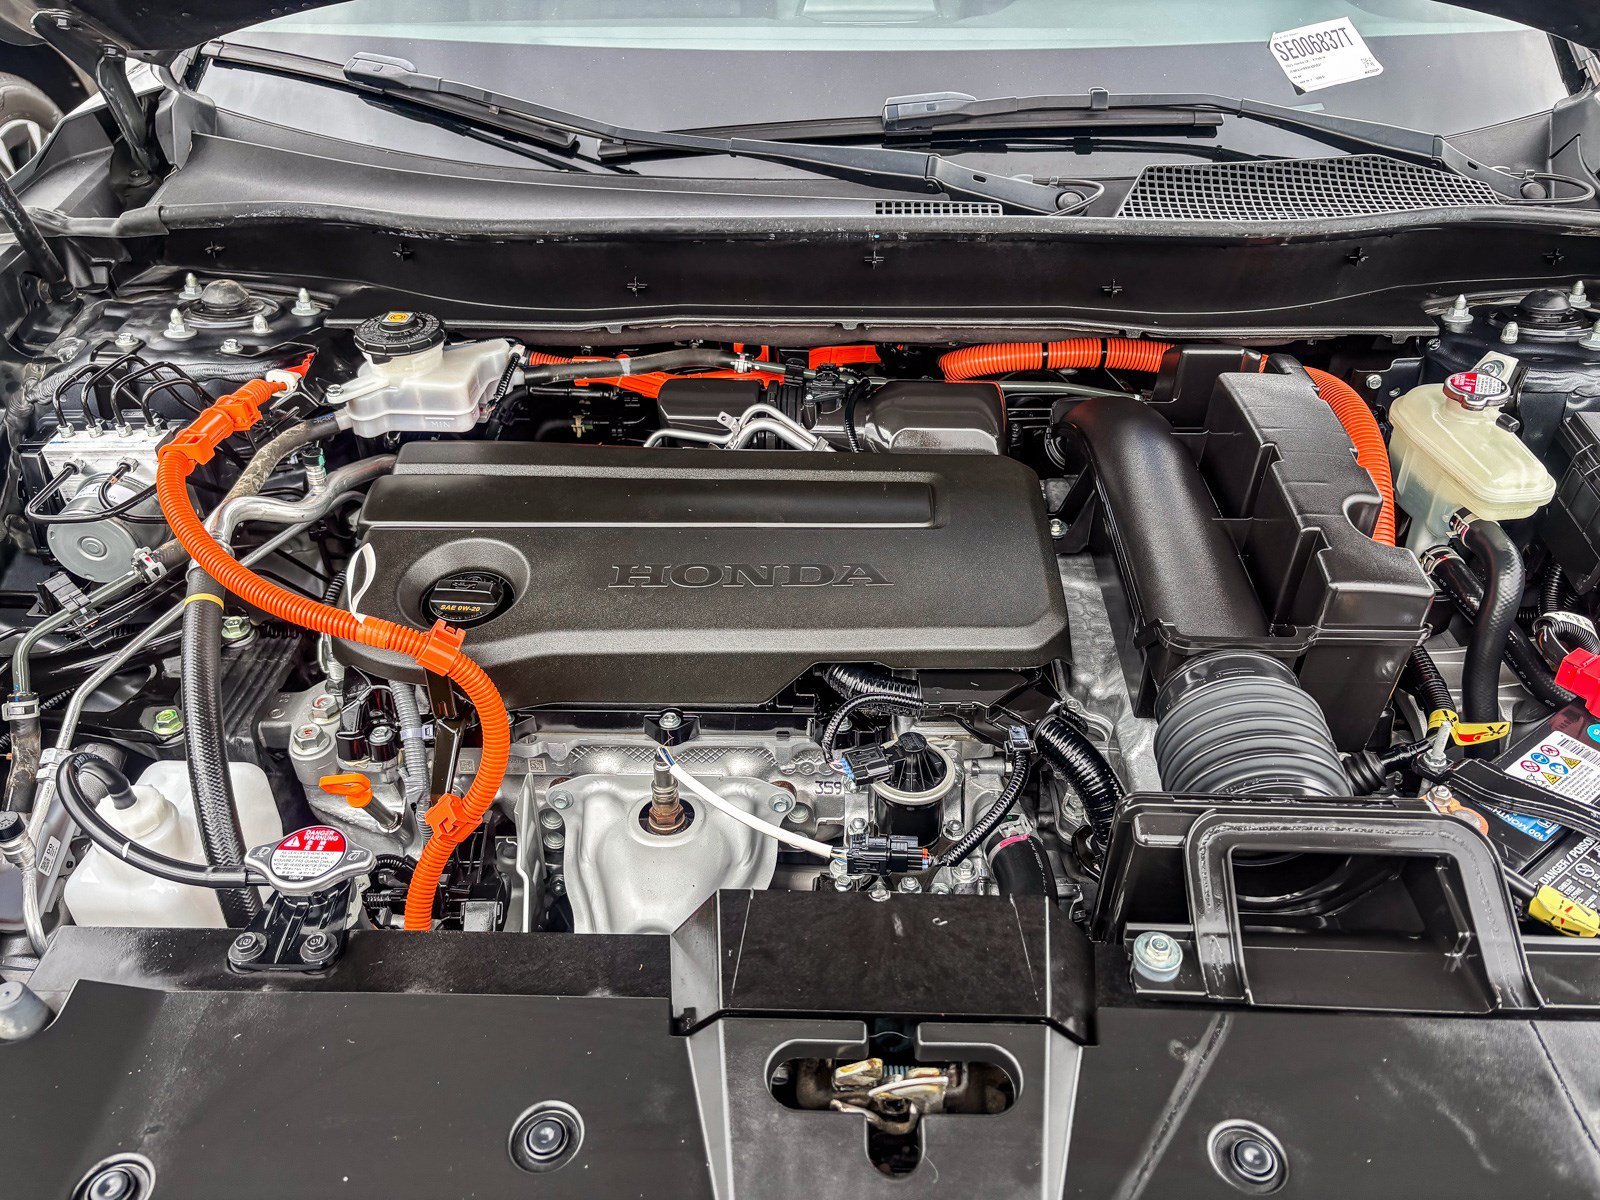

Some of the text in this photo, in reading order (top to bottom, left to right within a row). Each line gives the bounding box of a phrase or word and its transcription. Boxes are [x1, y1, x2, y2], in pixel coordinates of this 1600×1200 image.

[1274, 27, 1353, 61] SE006837T
[608, 564, 895, 588] HONDA
[815, 781, 842, 795] 359
[303, 834, 339, 842] WARNING
[305, 829, 335, 837] DANGER
[1528, 829, 1545, 840] 100
[1538, 859, 1569, 885] DANGER
